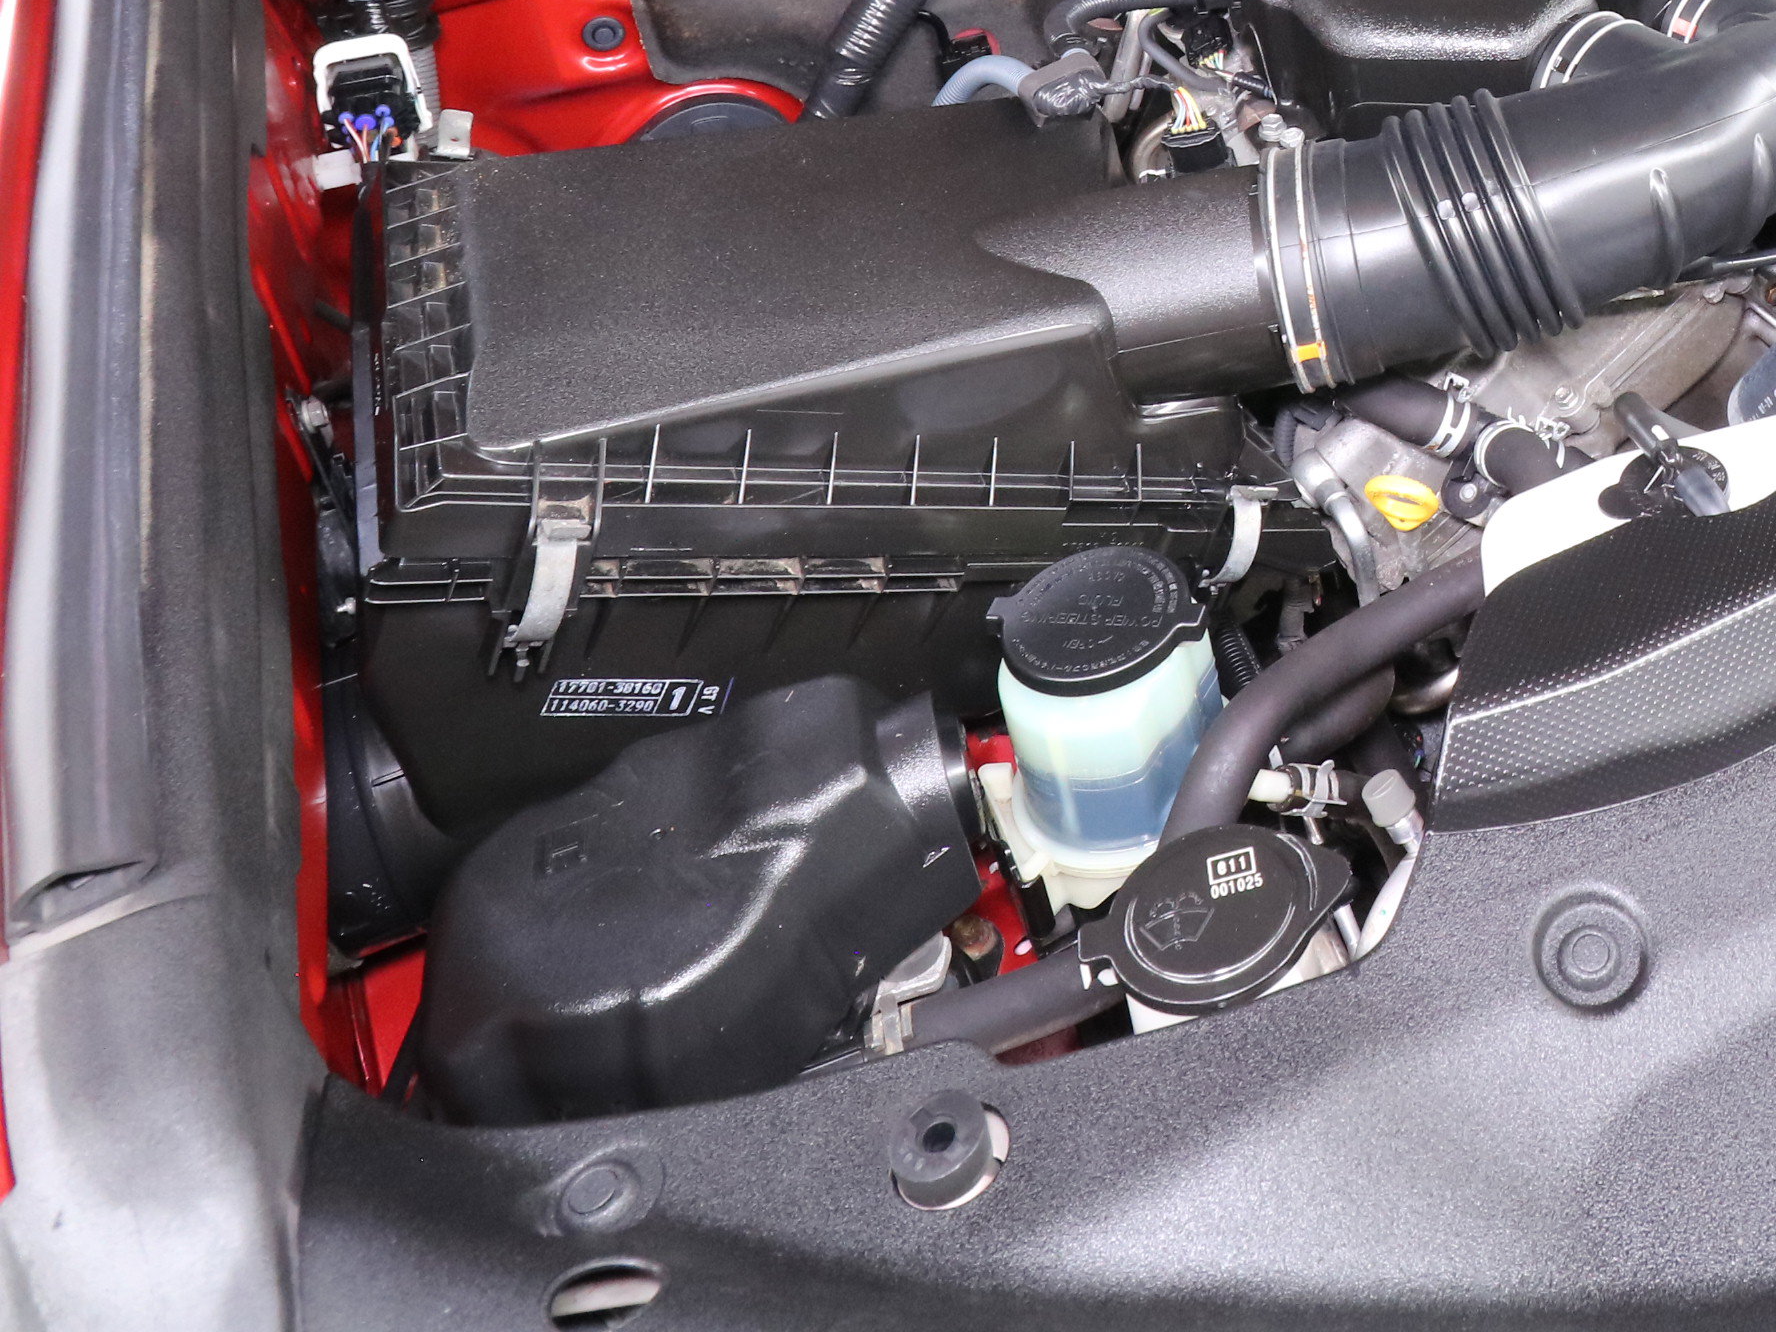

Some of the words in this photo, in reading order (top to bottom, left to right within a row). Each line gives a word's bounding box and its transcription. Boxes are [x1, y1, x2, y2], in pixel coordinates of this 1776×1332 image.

[1077, 592, 1125, 608] FLUID
[1020, 610, 1102, 627] STEERING
[1103, 612, 1164, 629] POWER
[550, 698, 655, 713] 114060-3290
[669, 686, 687, 711] 1
[1210, 872, 1263, 899] 001025
